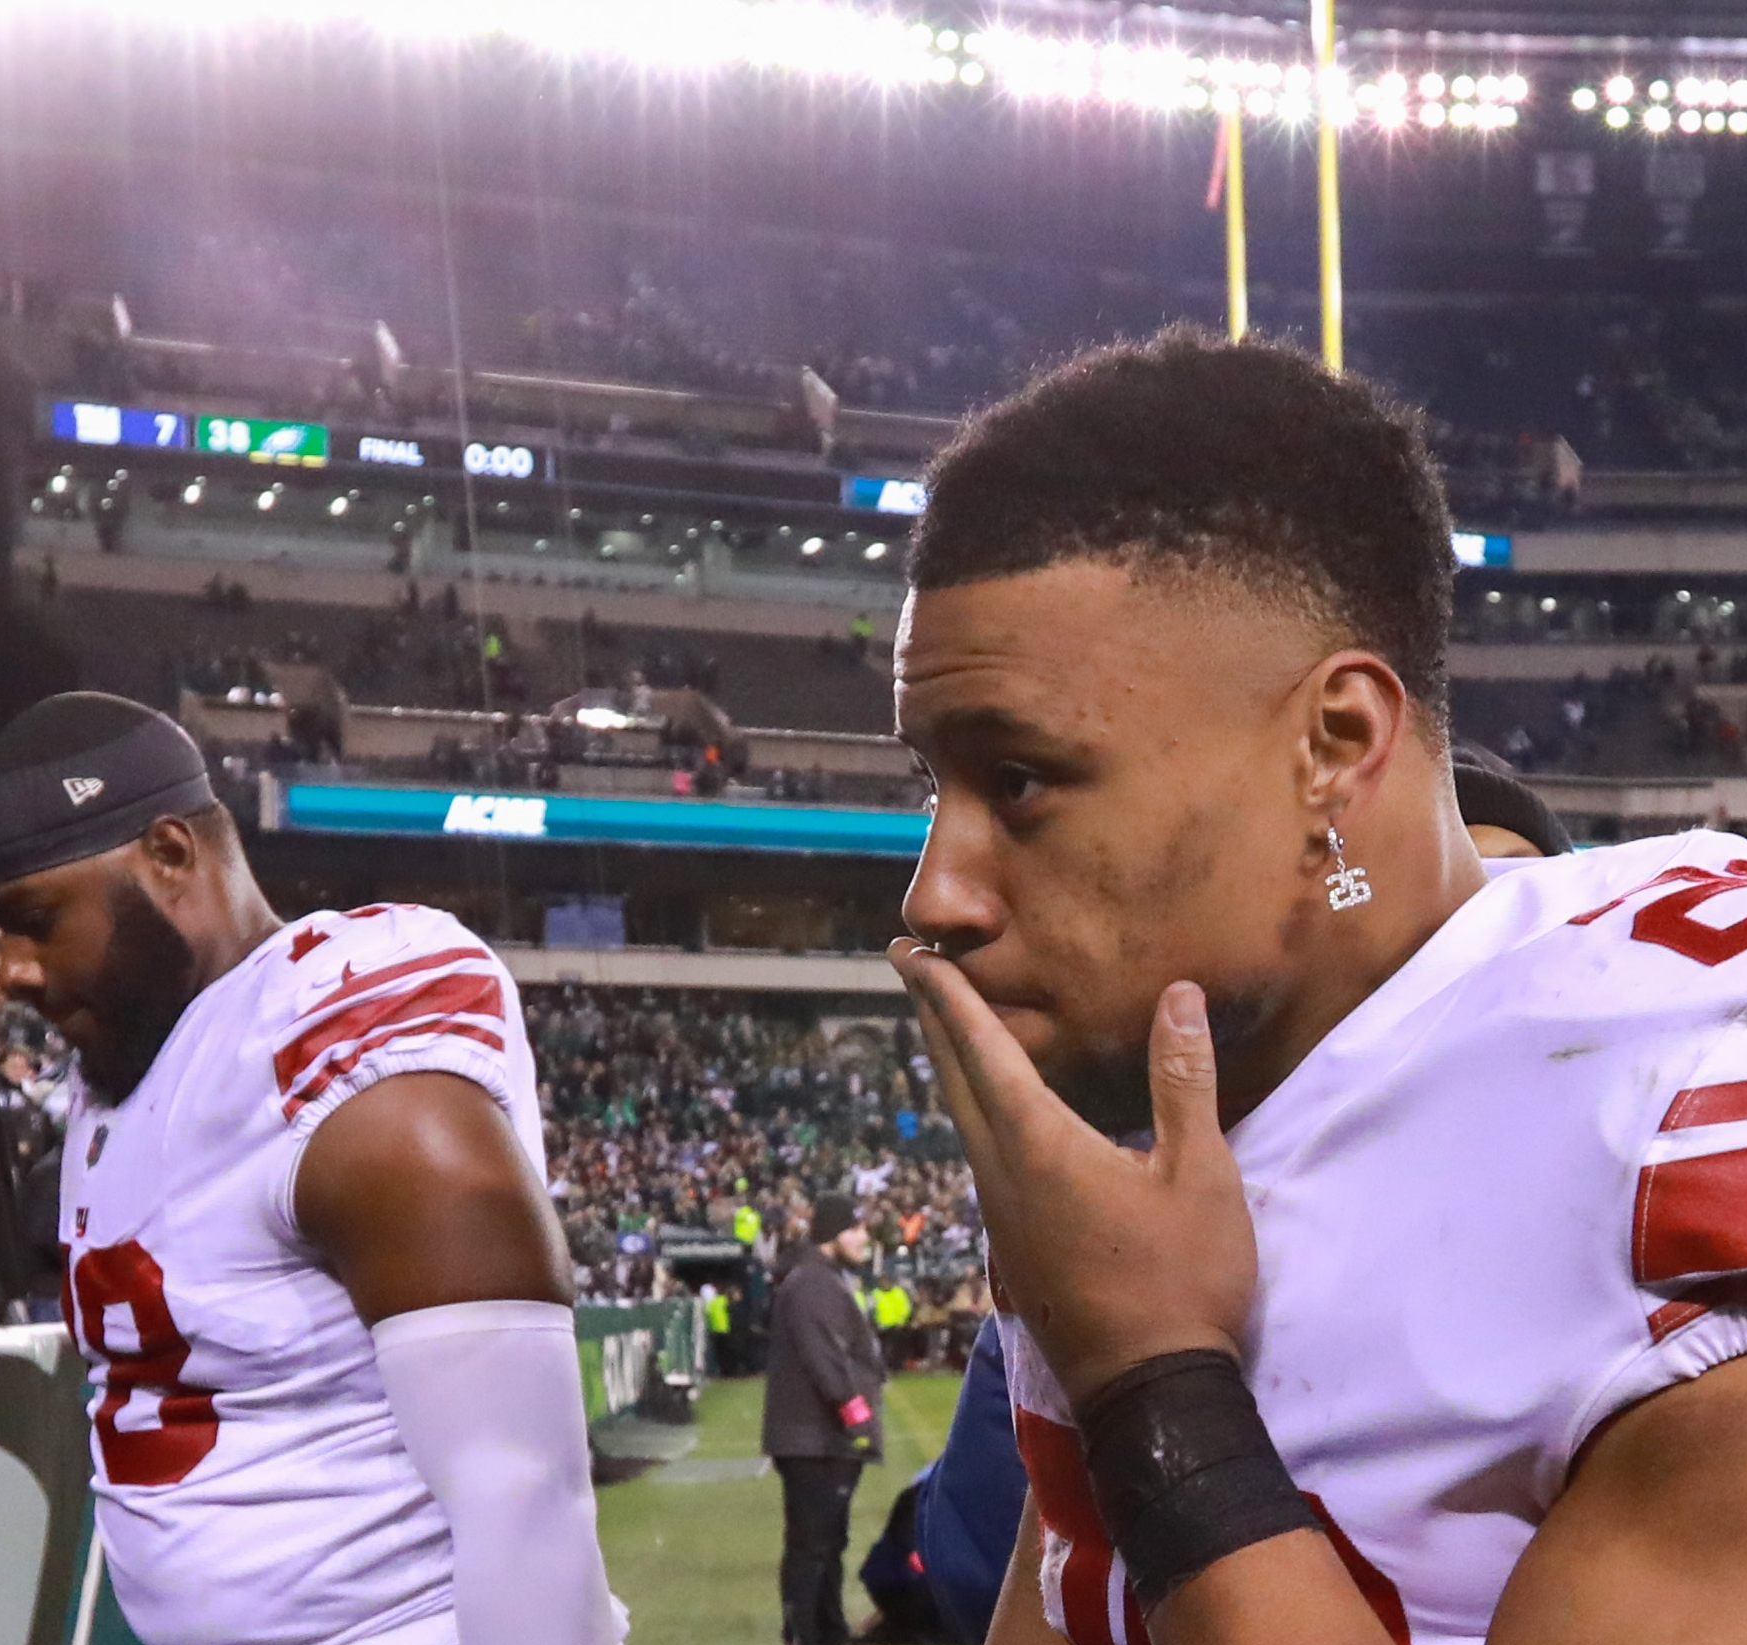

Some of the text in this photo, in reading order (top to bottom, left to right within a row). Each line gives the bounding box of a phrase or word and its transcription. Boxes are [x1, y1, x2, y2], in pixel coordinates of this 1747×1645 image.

[154, 413, 177, 447] 7
[207, 418, 251, 452] 38
[359, 436, 533, 478] FINAL 0:00
[443, 795, 548, 836] ACME
[1325, 867, 1372, 911] 26
